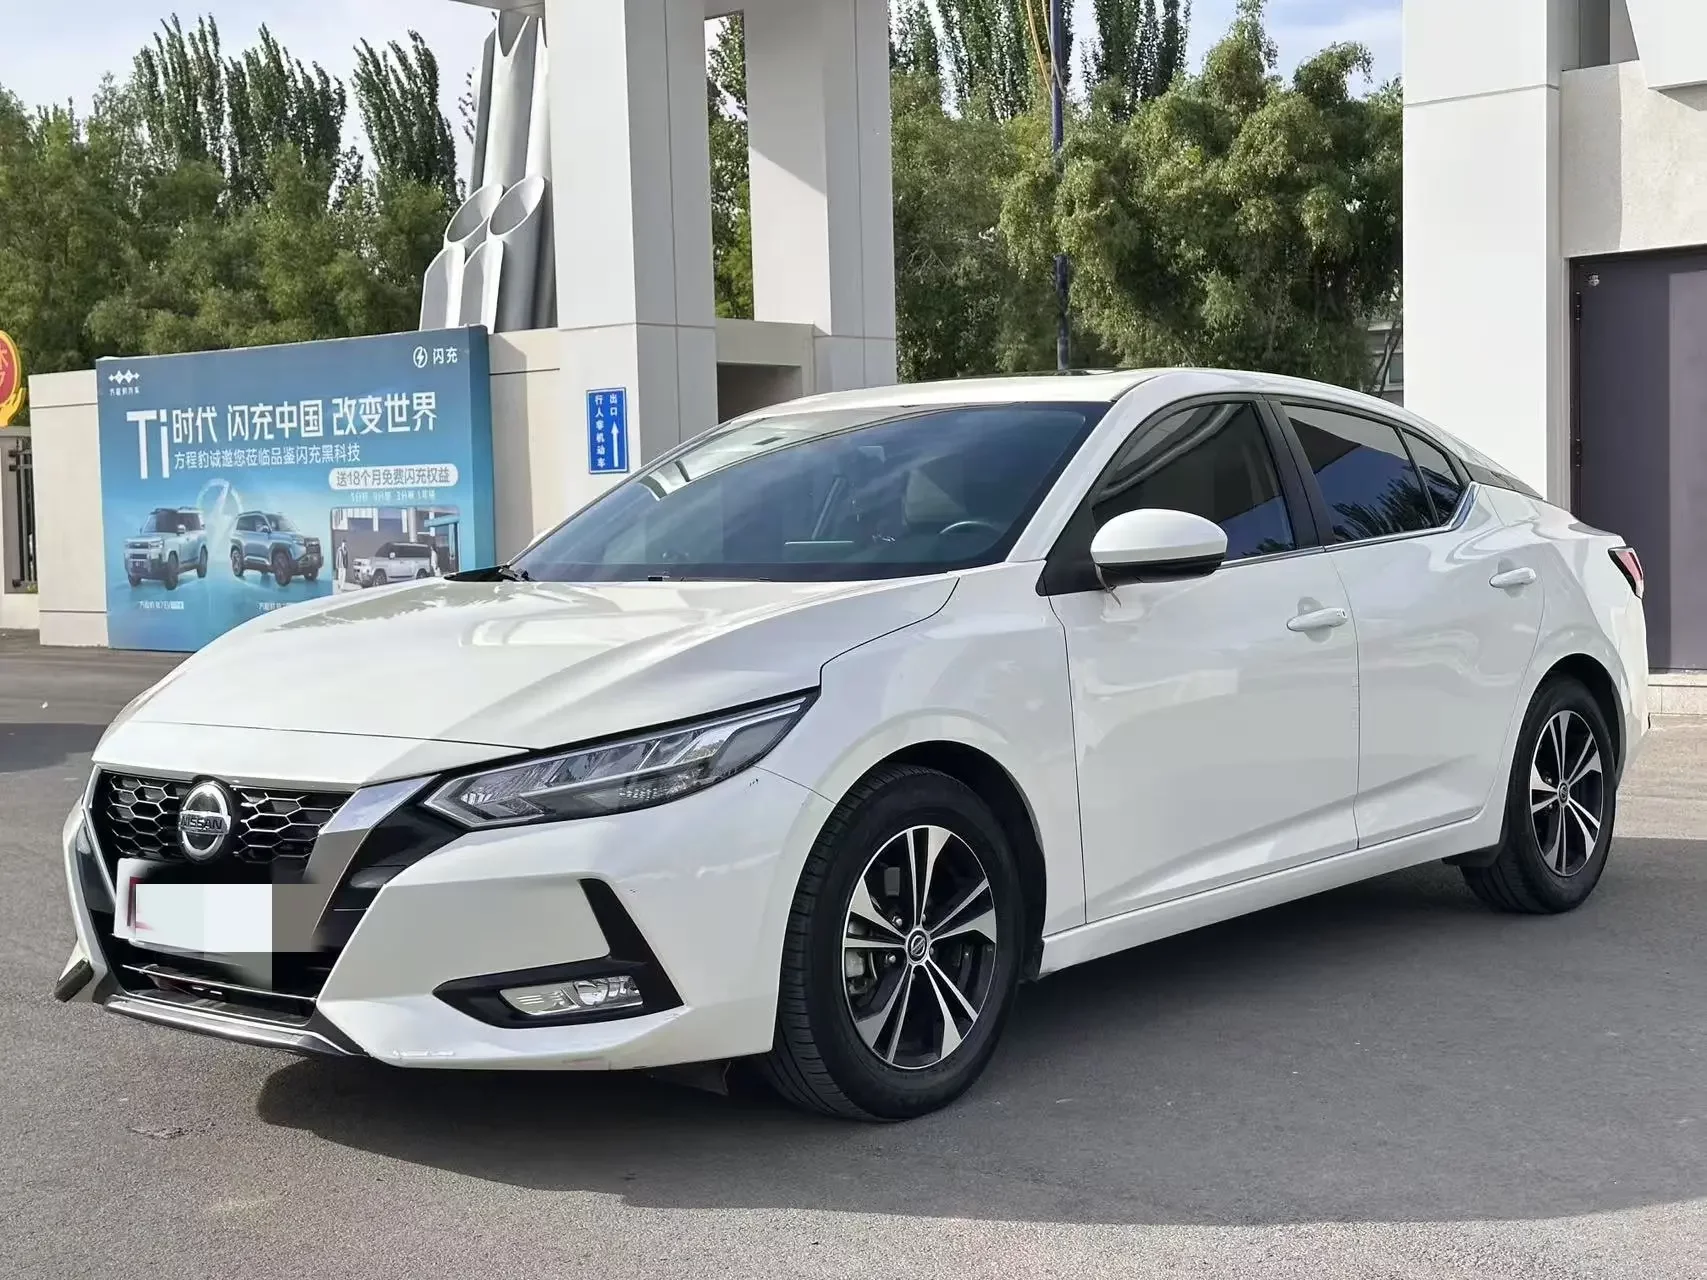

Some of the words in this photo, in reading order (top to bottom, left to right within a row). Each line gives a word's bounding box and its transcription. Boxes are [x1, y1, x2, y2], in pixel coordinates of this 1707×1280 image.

[433, 346, 458, 364] 闪充
[609, 393, 618, 417] 出口
[227, 400, 324, 442] 闪充中国
[331, 391, 437, 436] 改变世界
[336, 466, 451, 487] 送18个月免费闪充权益
[181, 814, 223, 830] NISSAN
